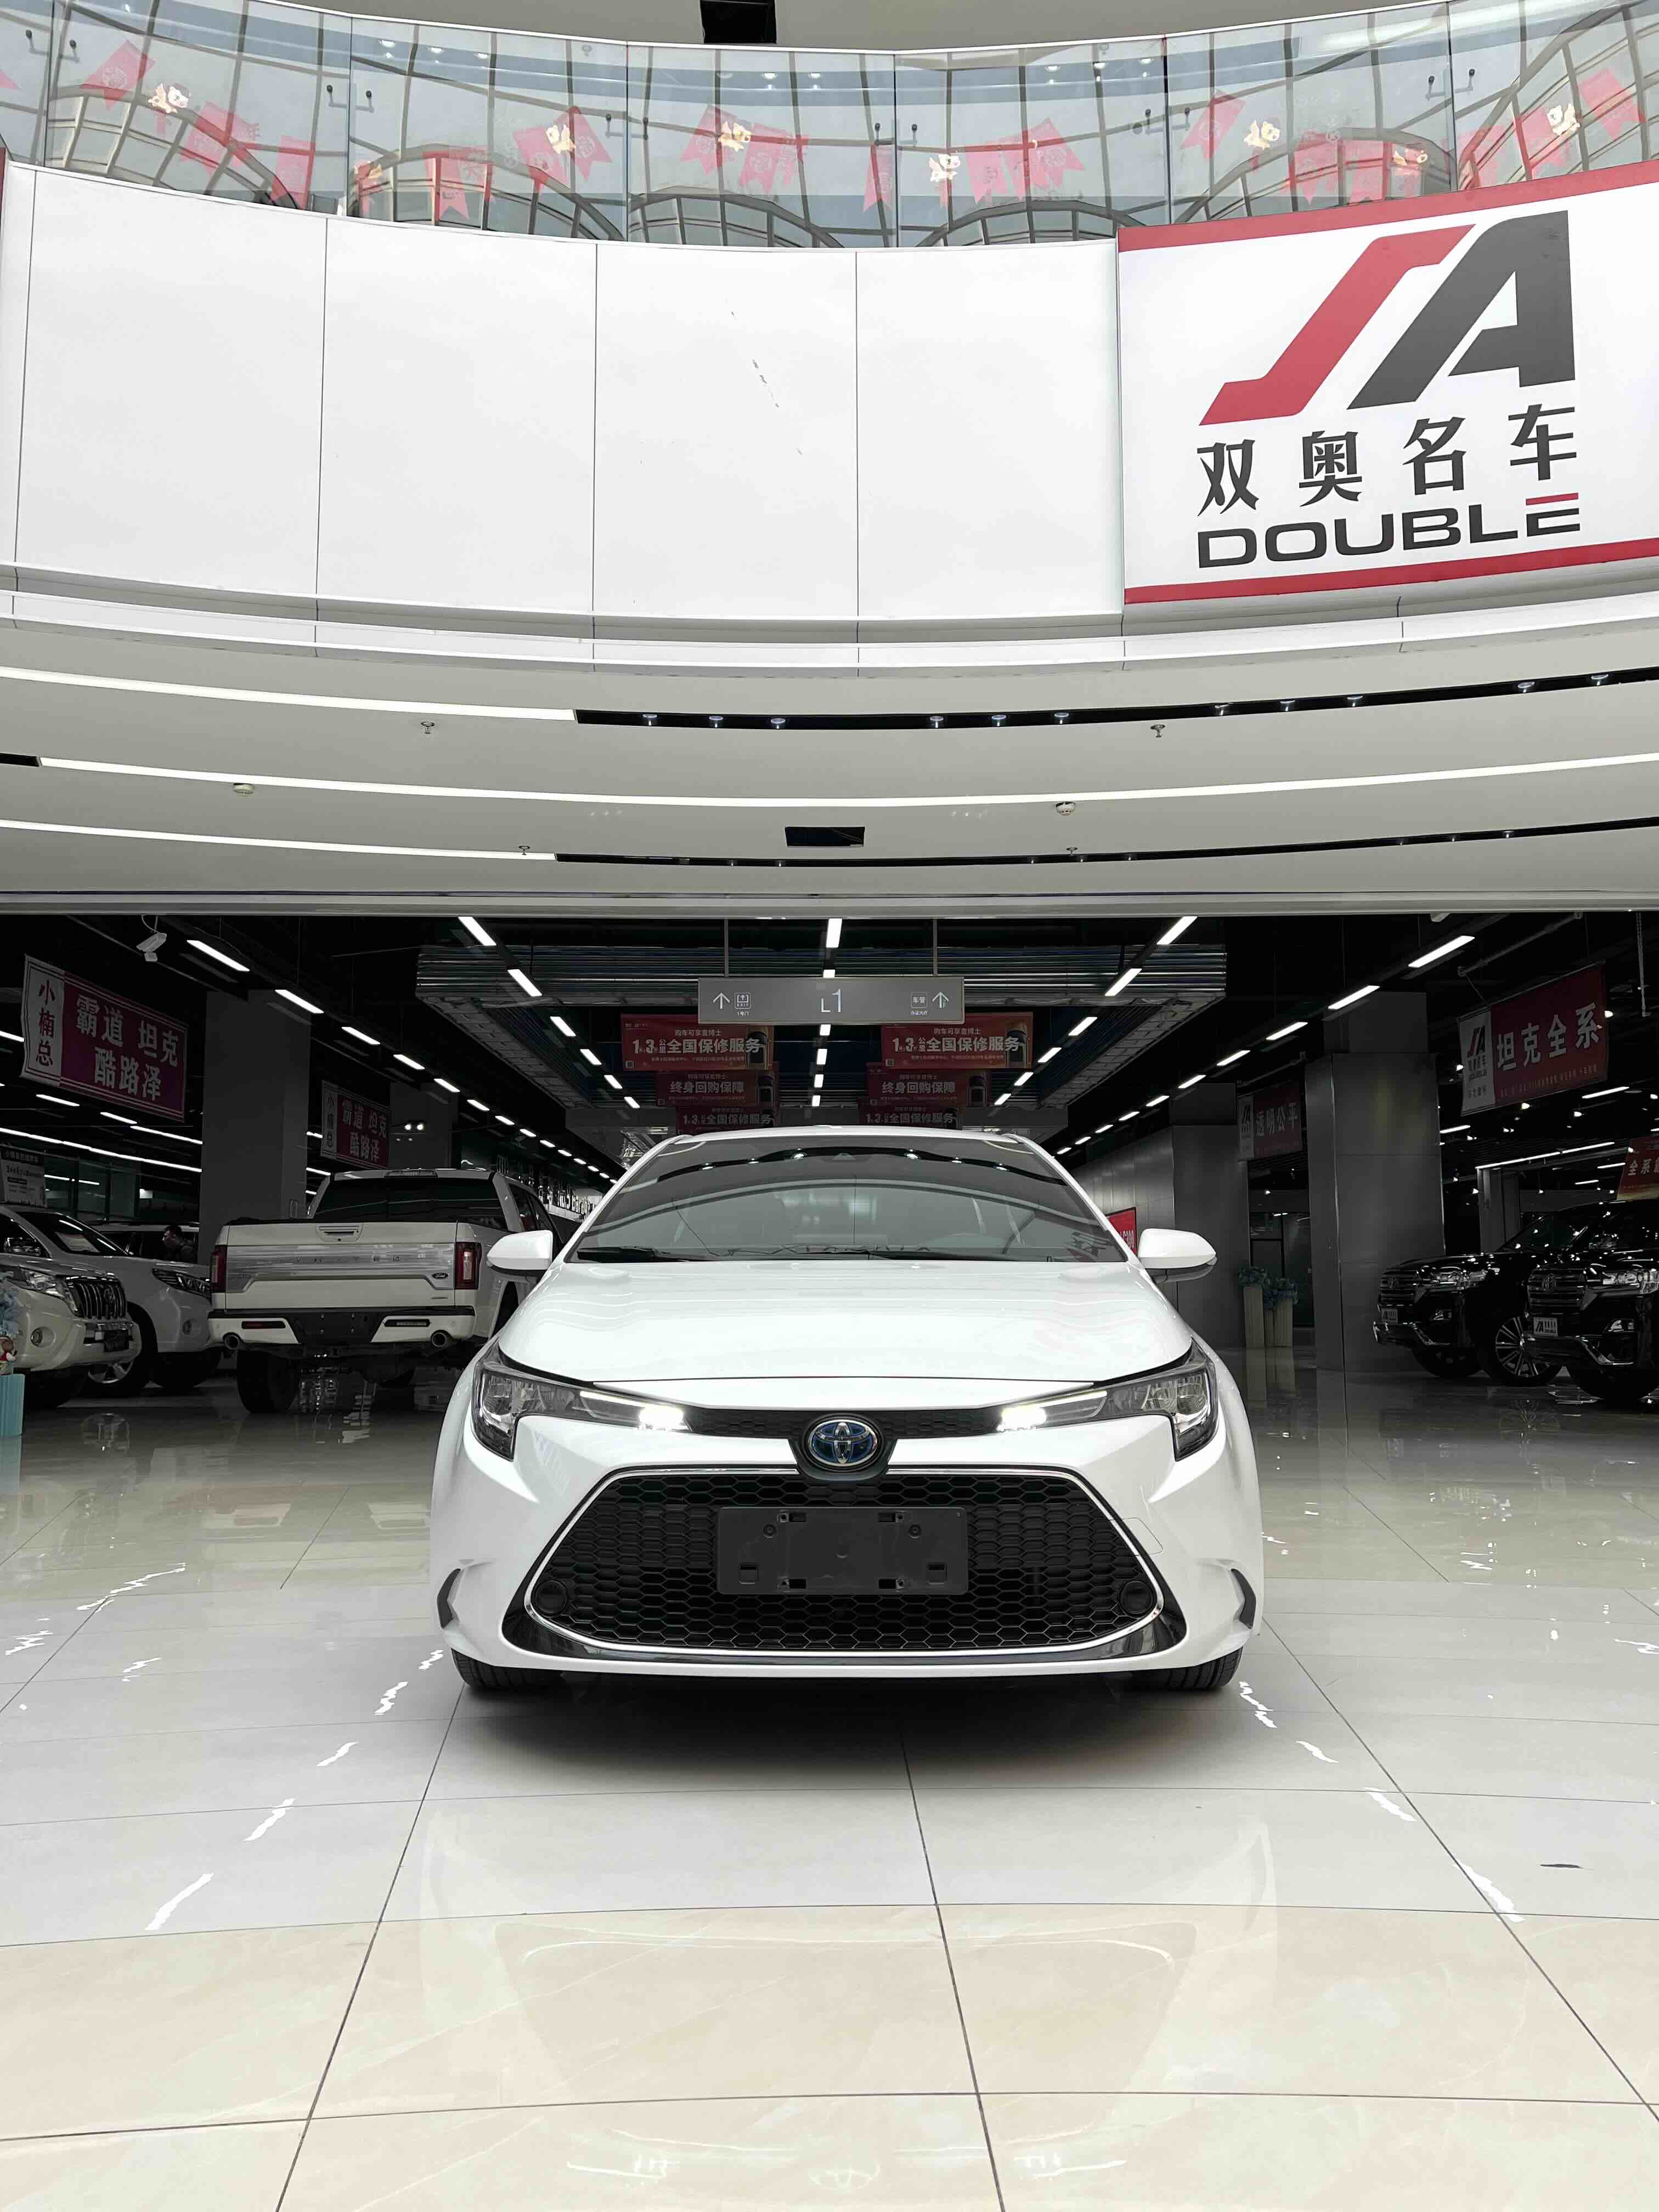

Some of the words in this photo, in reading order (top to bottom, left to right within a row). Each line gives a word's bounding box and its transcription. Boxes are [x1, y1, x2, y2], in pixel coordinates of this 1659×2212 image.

[1197, 404, 1577, 516] 双奥名车
[1198, 493, 1580, 568] DOUBLE
[35, 979, 56, 1066] 小楠总
[75, 994, 124, 1048] 霸道
[138, 1021, 179, 1068] 坦克
[821, 988, 842, 1012] L1
[912, 996, 926, 1005] 车管
[1497, 1001, 1600, 1071] 坦克全系
[94, 1047, 161, 1101] 酷路泽
[669, 1081, 745, 1093] 终身回购保障
[882, 1081, 956, 1094] 终身回购保障
